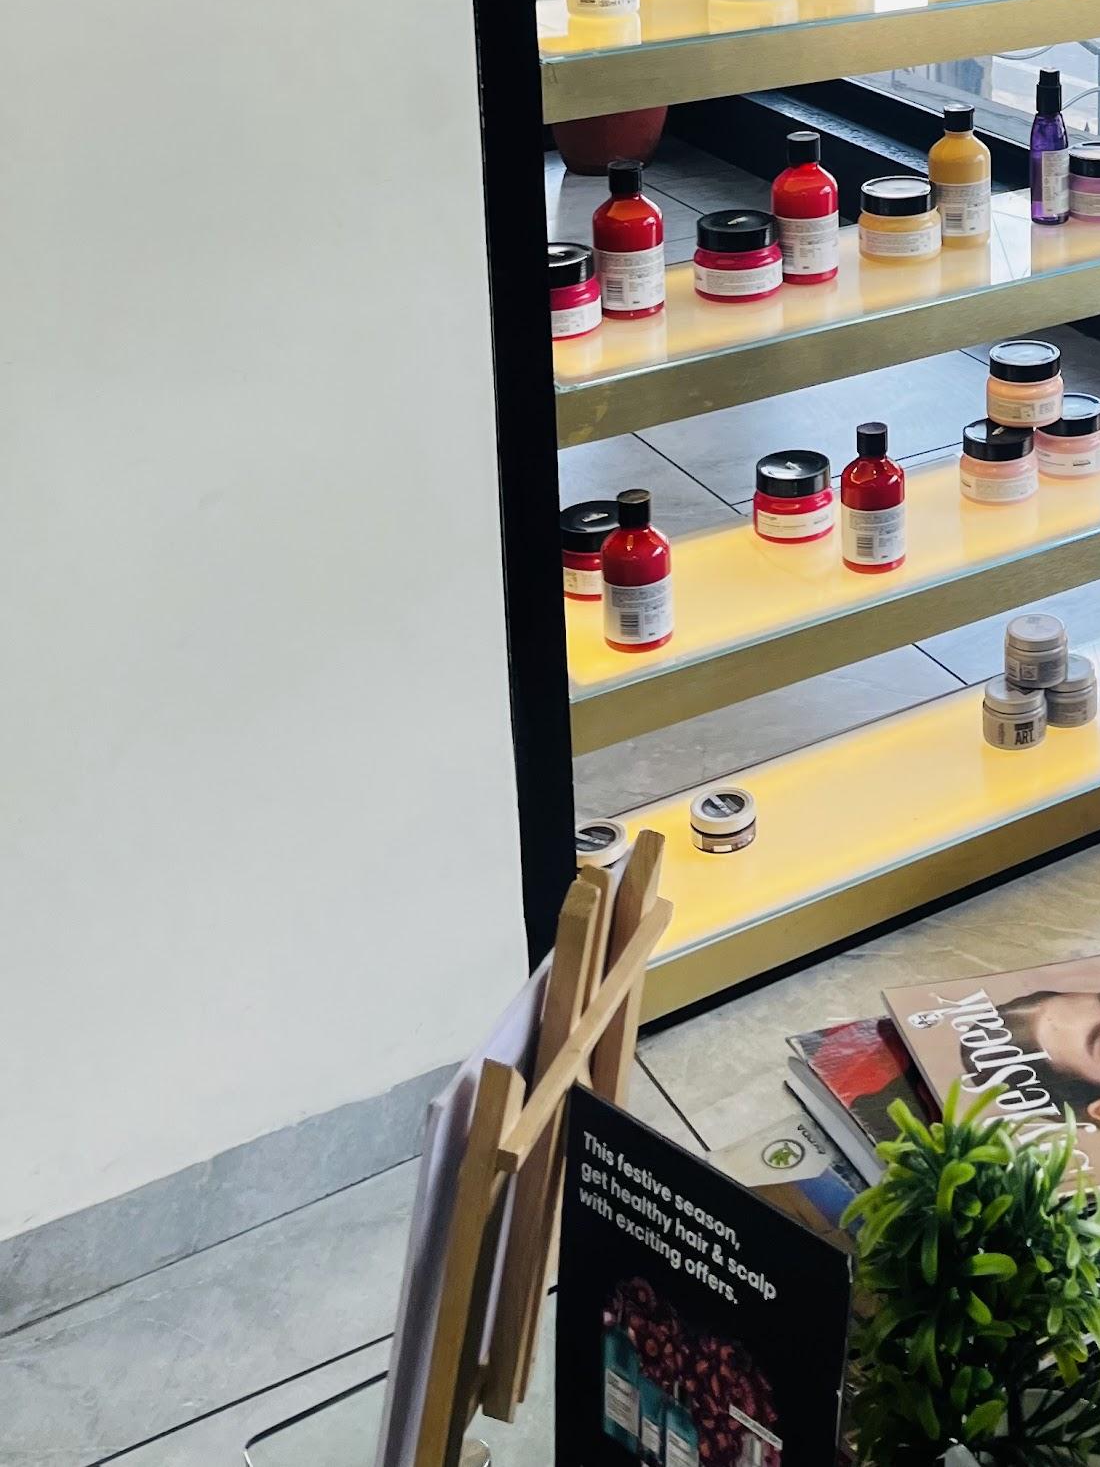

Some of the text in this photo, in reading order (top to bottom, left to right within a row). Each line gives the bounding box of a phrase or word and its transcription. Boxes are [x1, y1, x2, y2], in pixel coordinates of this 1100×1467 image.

[579, 1187, 738, 1305] with exciting offers.
[580, 1162, 777, 1301] get healthy hair & scalp
[583, 1130, 741, 1251] This festive season,
